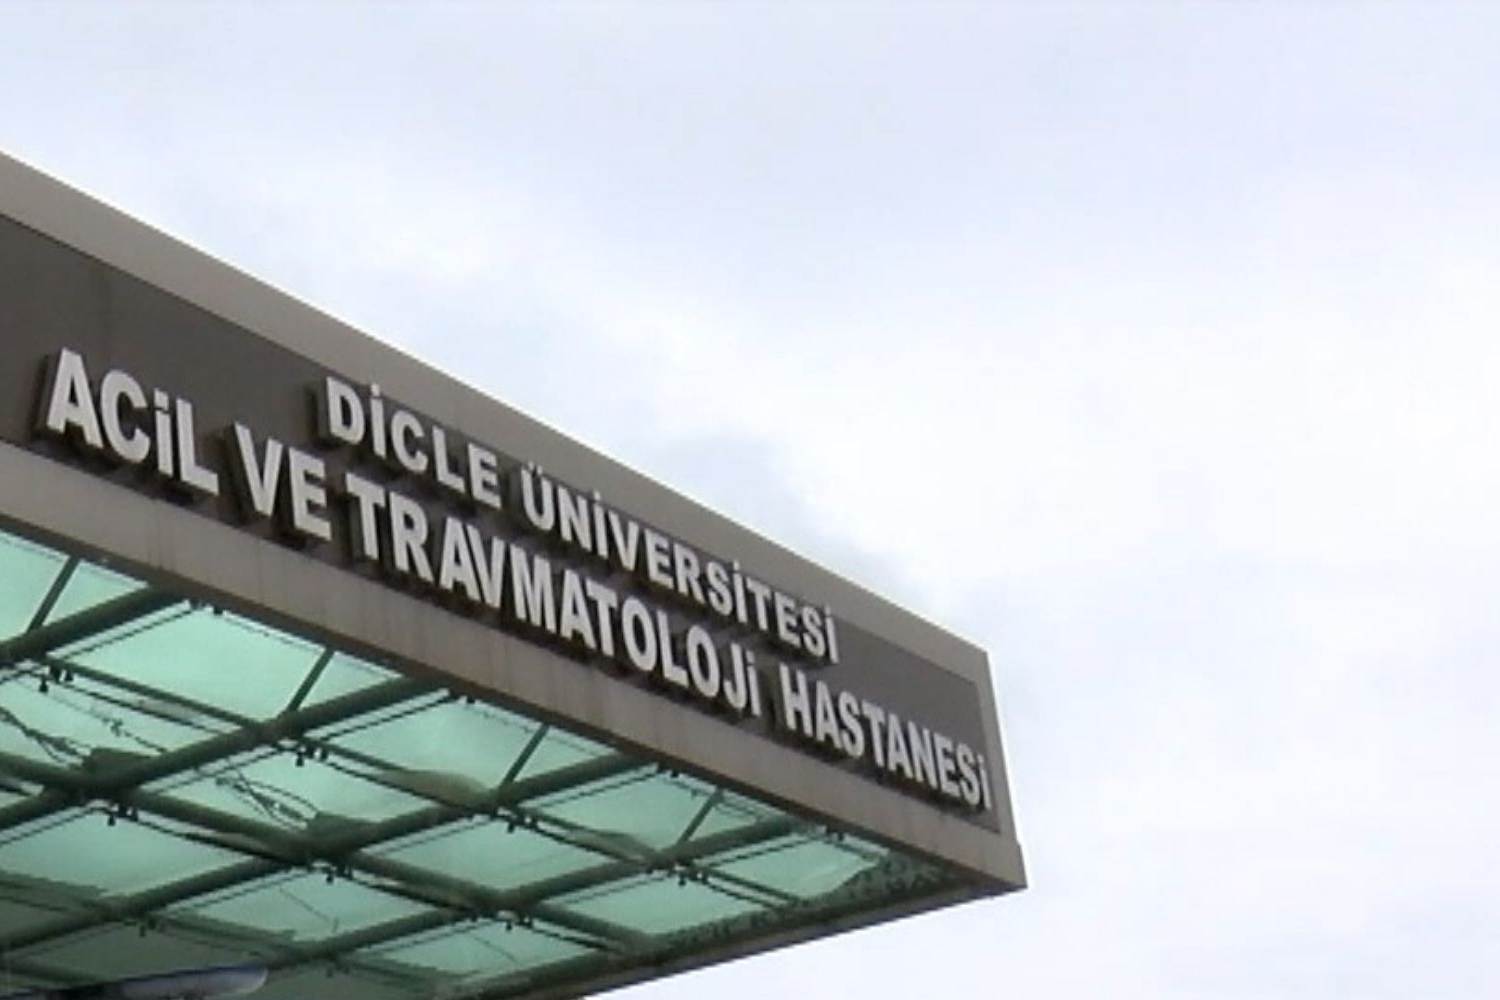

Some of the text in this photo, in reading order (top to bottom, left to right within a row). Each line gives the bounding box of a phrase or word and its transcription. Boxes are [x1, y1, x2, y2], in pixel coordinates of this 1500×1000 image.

[46, 347, 992, 810] ACİL VE TRAVMATOLOJİ HASTANESİ
[325, 376, 839, 664] DİCLE ÜNİVERSİTESİ
